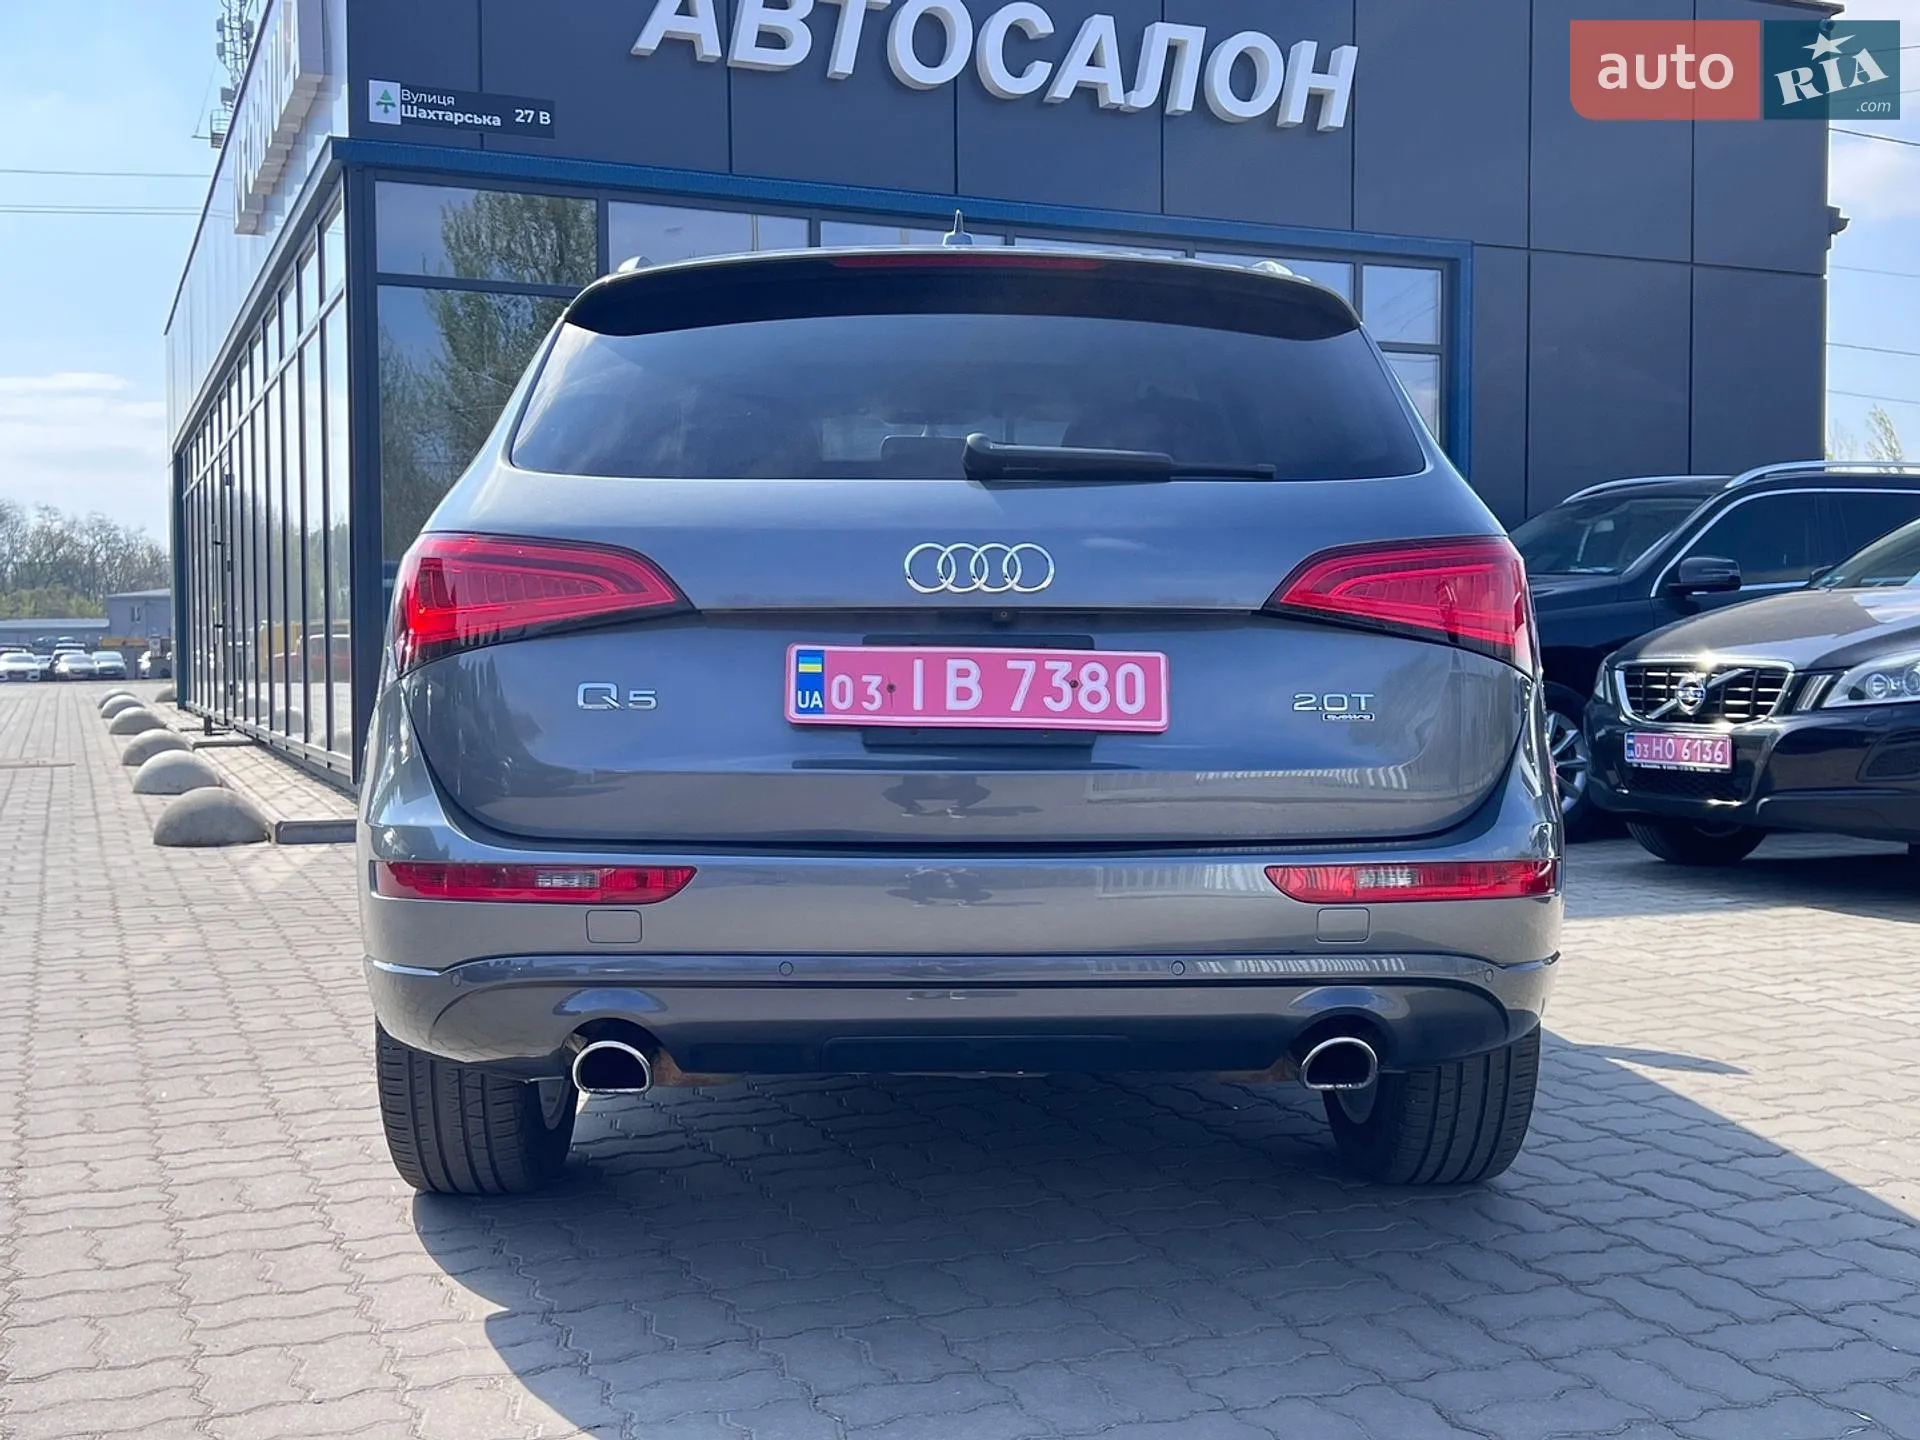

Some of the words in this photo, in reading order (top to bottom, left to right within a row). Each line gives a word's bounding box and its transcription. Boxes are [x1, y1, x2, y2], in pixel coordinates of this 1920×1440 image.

[631, 0, 1359, 132] АВТОСАЛОН
[401, 89, 455, 106] Вулиця
[401, 104, 501, 126] Шахтарська
[514, 109, 534, 124] 27
[577, 682, 657, 710] Q5
[831, 674, 883, 712] 03
[1006, 660, 1146, 715] 7380
[797, 690, 823, 709] UA
[1293, 693, 1374, 711] 2.0T
[1681, 739, 1724, 762] 6136
